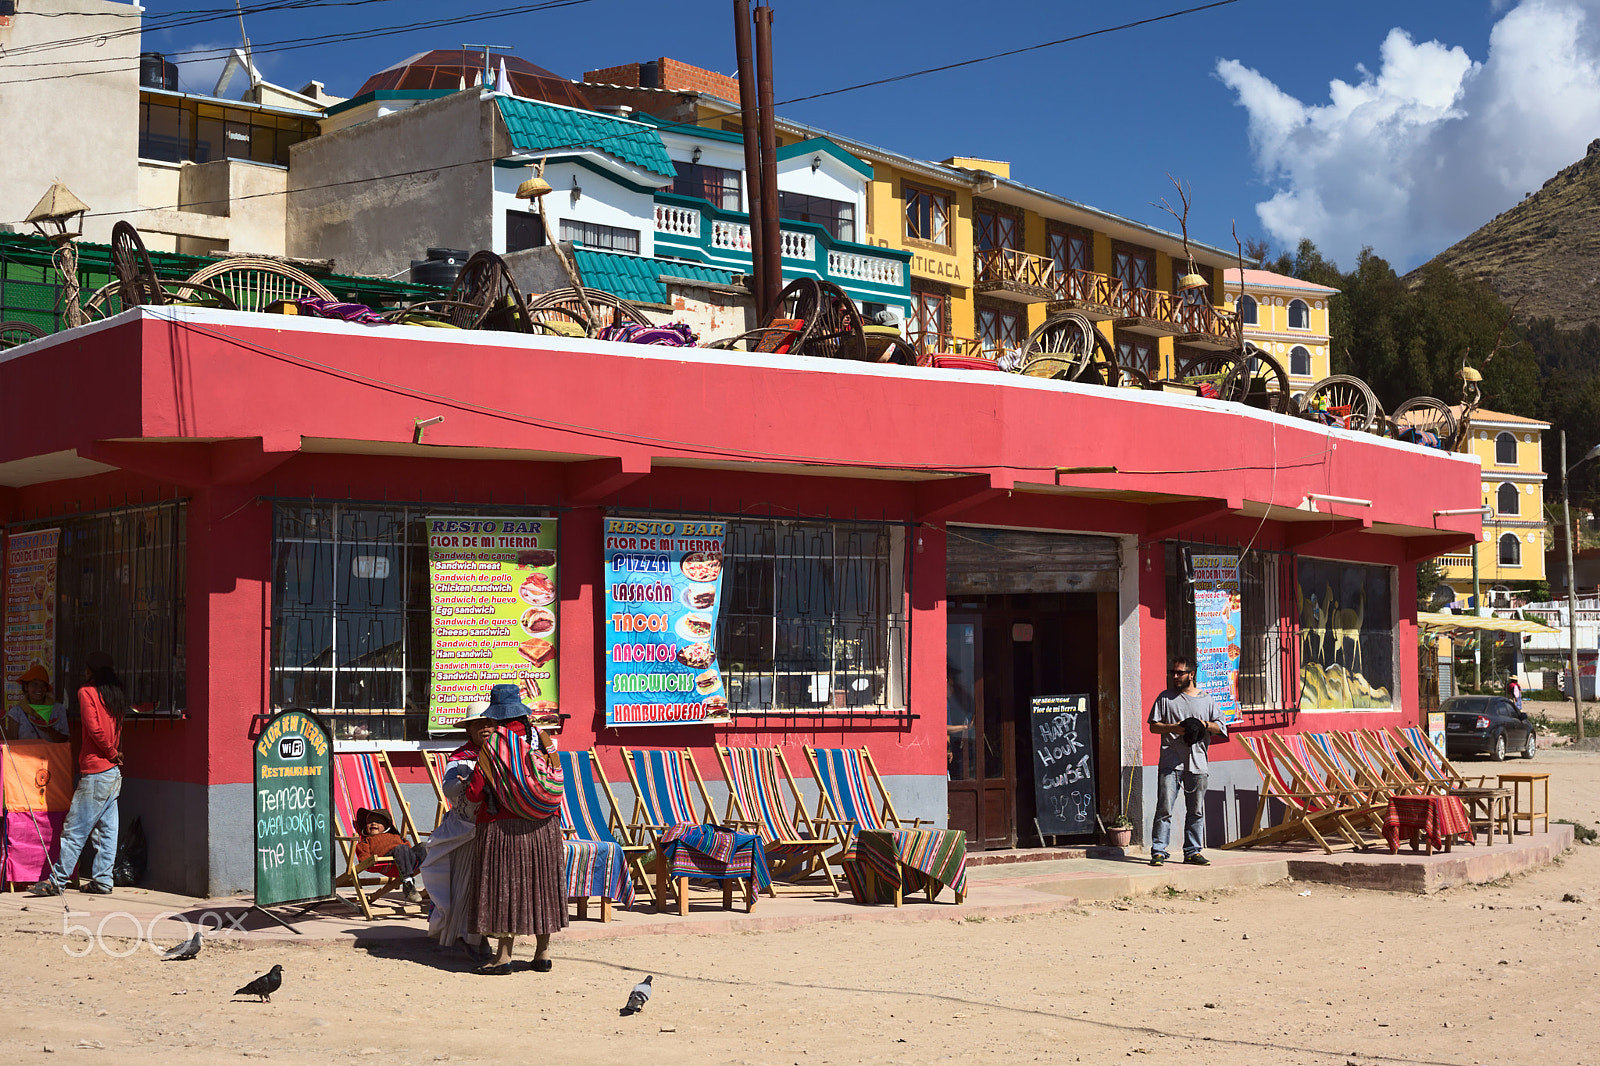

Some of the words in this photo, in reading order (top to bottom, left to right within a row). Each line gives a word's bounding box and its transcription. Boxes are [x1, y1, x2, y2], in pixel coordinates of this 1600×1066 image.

[903, 249, 960, 280] ITICACA
[431, 521, 497, 533] RESTO
[502, 522, 542, 533] BAR
[607, 521, 675, 535] RESTO
[681, 523, 723, 537] BAR
[430, 536, 459, 547] FLOR
[462, 536, 478, 547] DE
[481, 537, 495, 547] MI
[498, 537, 538, 547] TIERRA
[606, 537, 637, 550] FLOR
[640, 538, 656, 551] DE
[660, 539, 674, 551] MI
[678, 539, 721, 552] TIERRA
[435, 562, 477, 570] Sandwich
[478, 562, 501, 570] meat
[612, 553, 670, 573] PIZZA
[1194, 558, 1219, 568] RESTO
[1222, 558, 1237, 568] BAR
[491, 574, 512, 582] pollo
[1206, 570, 1212, 579] DE
[1214, 569, 1220, 579] MI
[435, 584, 470, 592] Chicken
[471, 584, 512, 592] sandwich
[611, 581, 673, 603] LASAGÑA
[436, 606, 453, 615] Egg
[455, 606, 495, 614] sandwich
[612, 614, 669, 632] TACOS
[436, 628, 468, 636] Cheese
[469, 628, 510, 636] sandwich
[492, 641, 519, 649] jamon
[436, 650, 454, 658] Ham
[456, 650, 492, 658] sandwich
[612, 644, 677, 663] NACHOS
[436, 672, 478, 680] Sandwich
[480, 672, 499, 680] Ham
[518, 671, 550, 679] Cheese
[612, 673, 695, 693] SANDWICHS
[613, 703, 707, 722] HAMBURGUESAS
[1038, 713, 1078, 743] HAPPY
[258, 721, 281, 757] FLOR
[282, 742, 302, 754] WiFi
[1037, 731, 1084, 767] HOUR
[259, 786, 316, 813] Terrace
